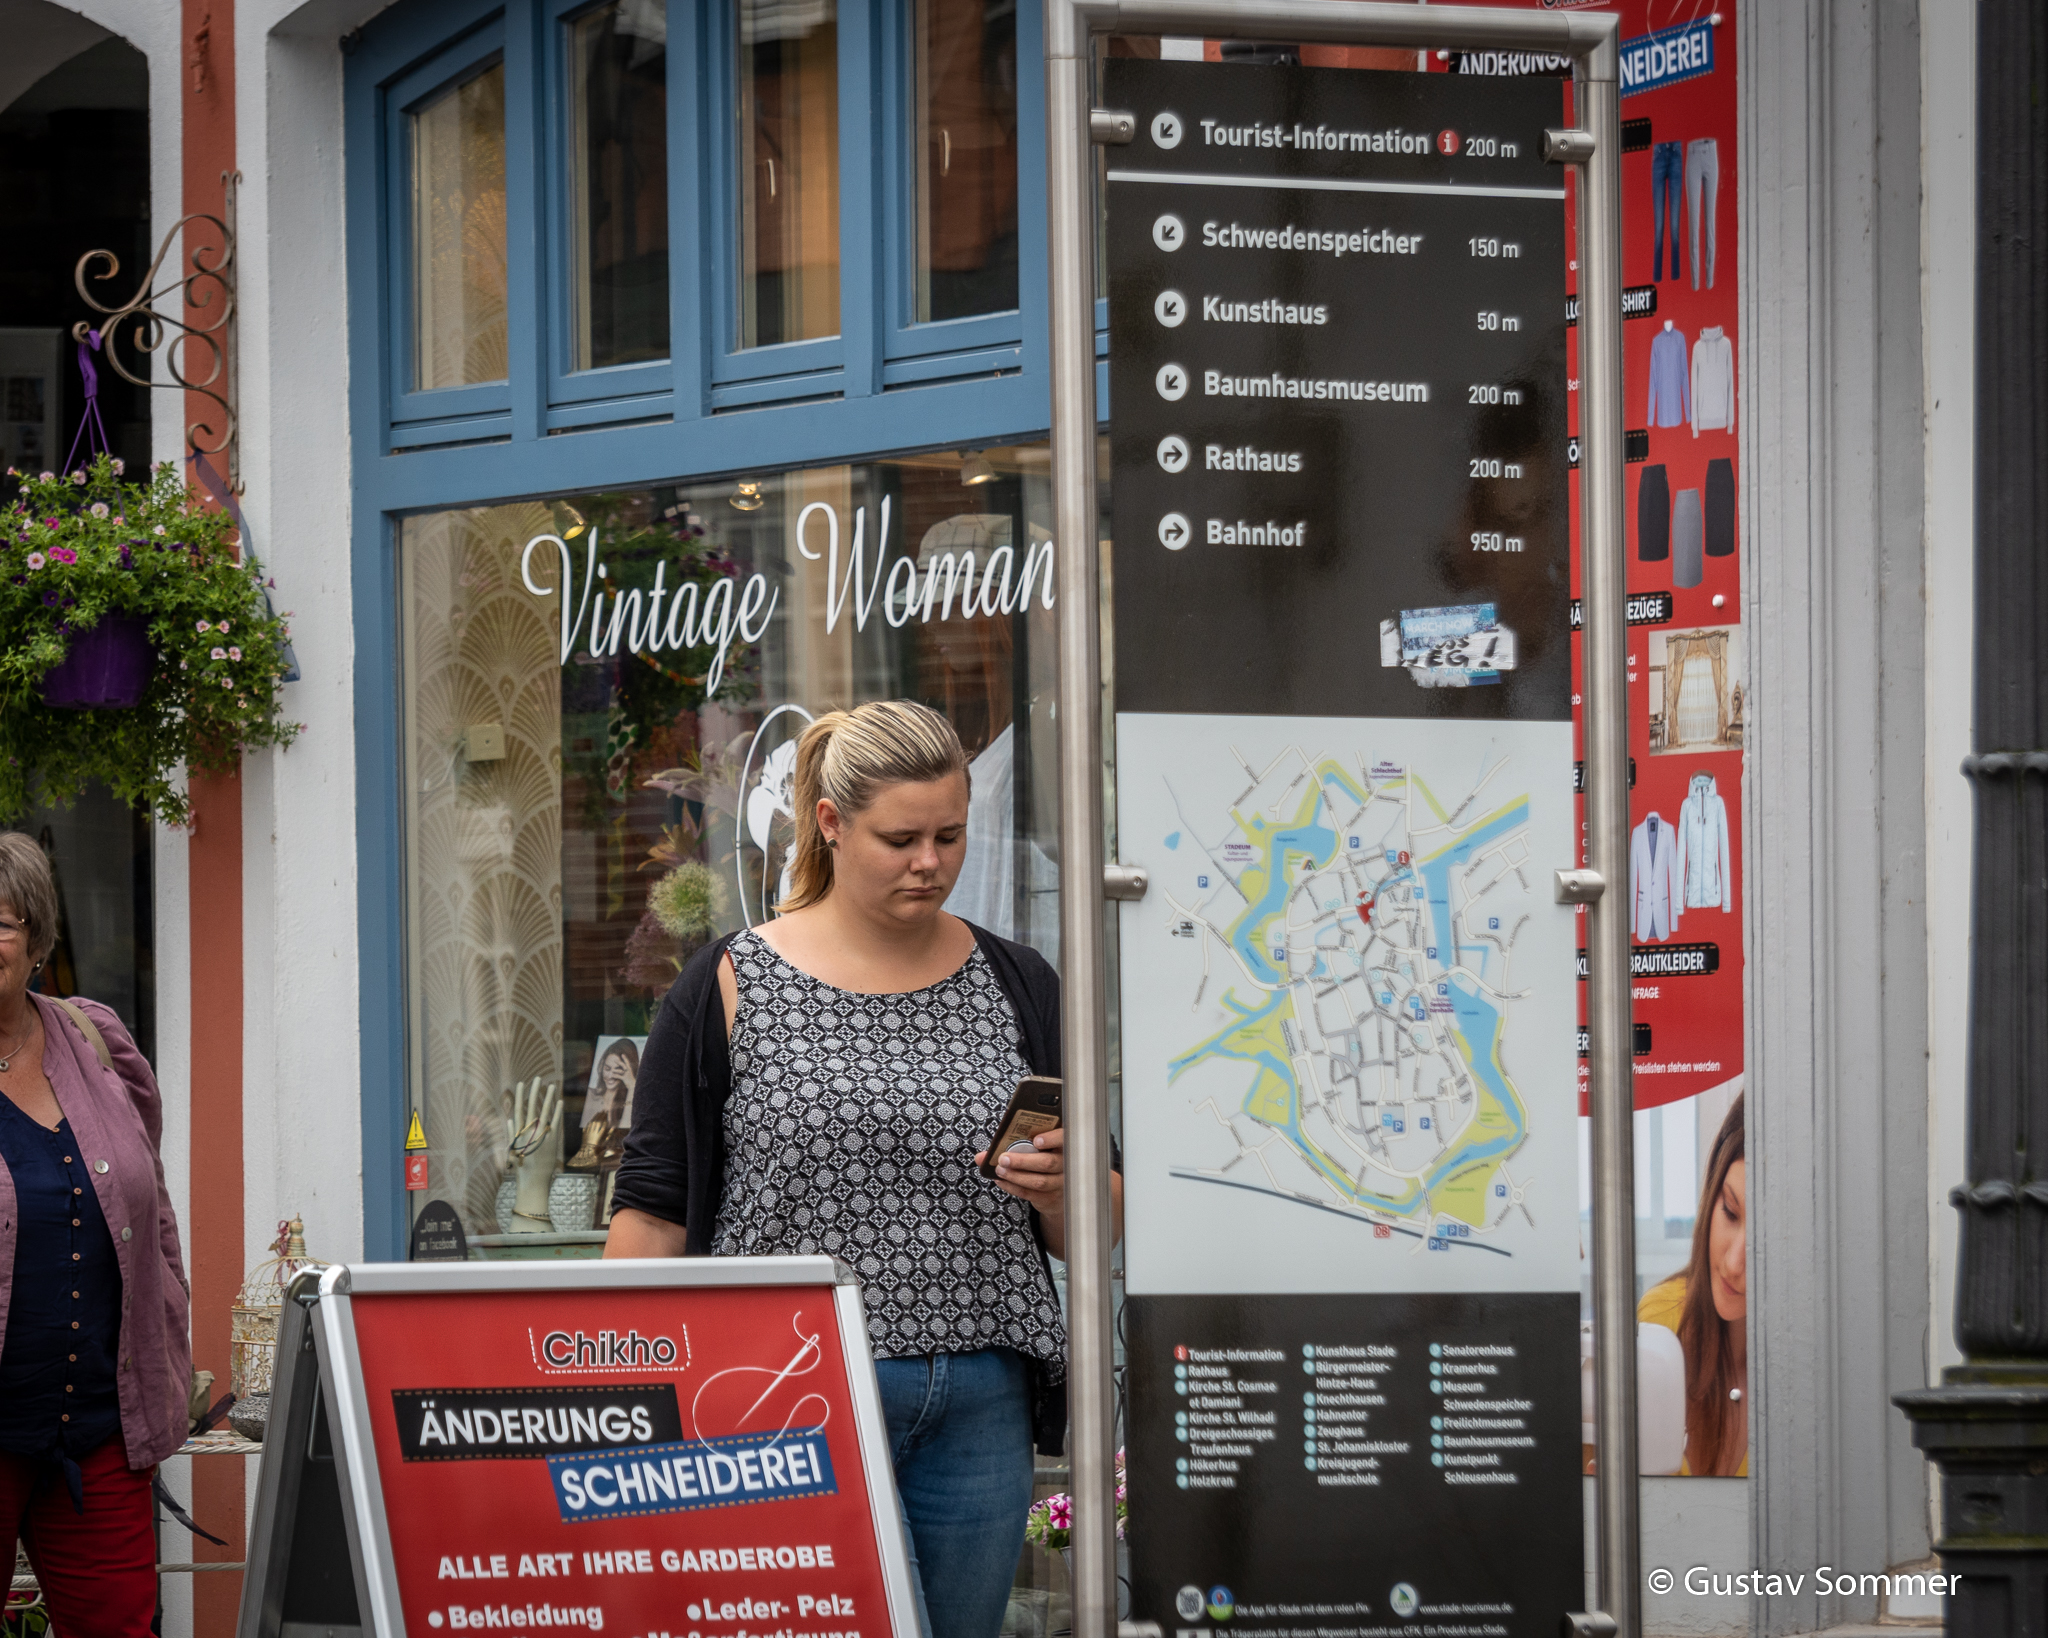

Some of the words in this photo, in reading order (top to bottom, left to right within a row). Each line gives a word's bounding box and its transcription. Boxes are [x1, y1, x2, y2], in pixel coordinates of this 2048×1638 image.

[1200, 121, 1428, 154] Tourist-Information
[1465, 138, 1498, 158] 200
[1500, 143, 1517, 159] m
[1202, 222, 1421, 257] Schwedenspeicher
[1468, 237, 1498, 258] 150
[1502, 242, 1519, 258] m
[1203, 297, 1327, 326] Kunsthaus
[1477, 312, 1498, 332] 50
[1502, 316, 1519, 332] m
[1204, 371, 1428, 404] Baumhausmuseum
[1468, 385, 1499, 406] 200
[1502, 389, 1519, 405] m
[1205, 445, 1302, 473] Rathaus
[1469, 459, 1500, 480] 200
[1504, 463, 1521, 480] m
[1206, 520, 1305, 548] Bahnhof
[1470, 532, 1500, 553] 950
[1505, 537, 1522, 553] m
[521, 527, 779, 698] Vintage
[796, 494, 1056, 634] Woman
[1406, 620, 1443, 634] MARCH
[1445, 619, 1474, 630] NOW
[1667, 1060, 1692, 1073] stehen
[1693, 1059, 1721, 1072] werden
[542, 1331, 676, 1369] Chikho
[1188, 1349, 1285, 1361] Tourist-Information
[1315, 1345, 1366, 1357] Kunsthaus
[1366, 1344, 1397, 1357] Stade
[1443, 1344, 1516, 1357] Senatorenhaus
[1188, 1365, 1229, 1377] Rathaus
[1443, 1362, 1498, 1375] Kramerhus
[1188, 1380, 1220, 1392] Kirche
[1237, 1380, 1277, 1392] Cosmae
[1443, 1381, 1485, 1393] Museum
[1316, 1393, 1386, 1405] Knechthausen
[1443, 1399, 1533, 1413] Schwedenspeicher
[1189, 1412, 1220, 1424] Kirche
[1317, 1409, 1368, 1422] Hahnentor
[419, 1402, 653, 1446] ÄNDERUNGS
[1443, 1417, 1525, 1429] Freilichtmuseum
[1190, 1427, 1276, 1442] Dreigeschossiges
[1317, 1425, 1366, 1439] Zeughaus
[1333, 1441, 1411, 1453] Johanniskloster
[1443, 1435, 1536, 1447] Baumhausmuseum
[1190, 1443, 1253, 1456] Traufenhaus
[1190, 1459, 1239, 1472] Hökerhus
[1444, 1453, 1501, 1467] Kunstpunkt
[561, 1442, 822, 1510] SCHNEIDEREI
[1190, 1475, 1236, 1487] Holzkran
[1318, 1473, 1379, 1486] musikschule
[1444, 1471, 1518, 1484] Schleusenhaus
[438, 1555, 508, 1579] ALLE
[518, 1552, 573, 1576] ART
[583, 1549, 653, 1575] IHRE
[661, 1545, 834, 1572] GARDEROBE
[448, 1603, 604, 1631] Bekleidung
[703, 1597, 790, 1623] Leder-
[799, 1593, 855, 1618] Pelz
